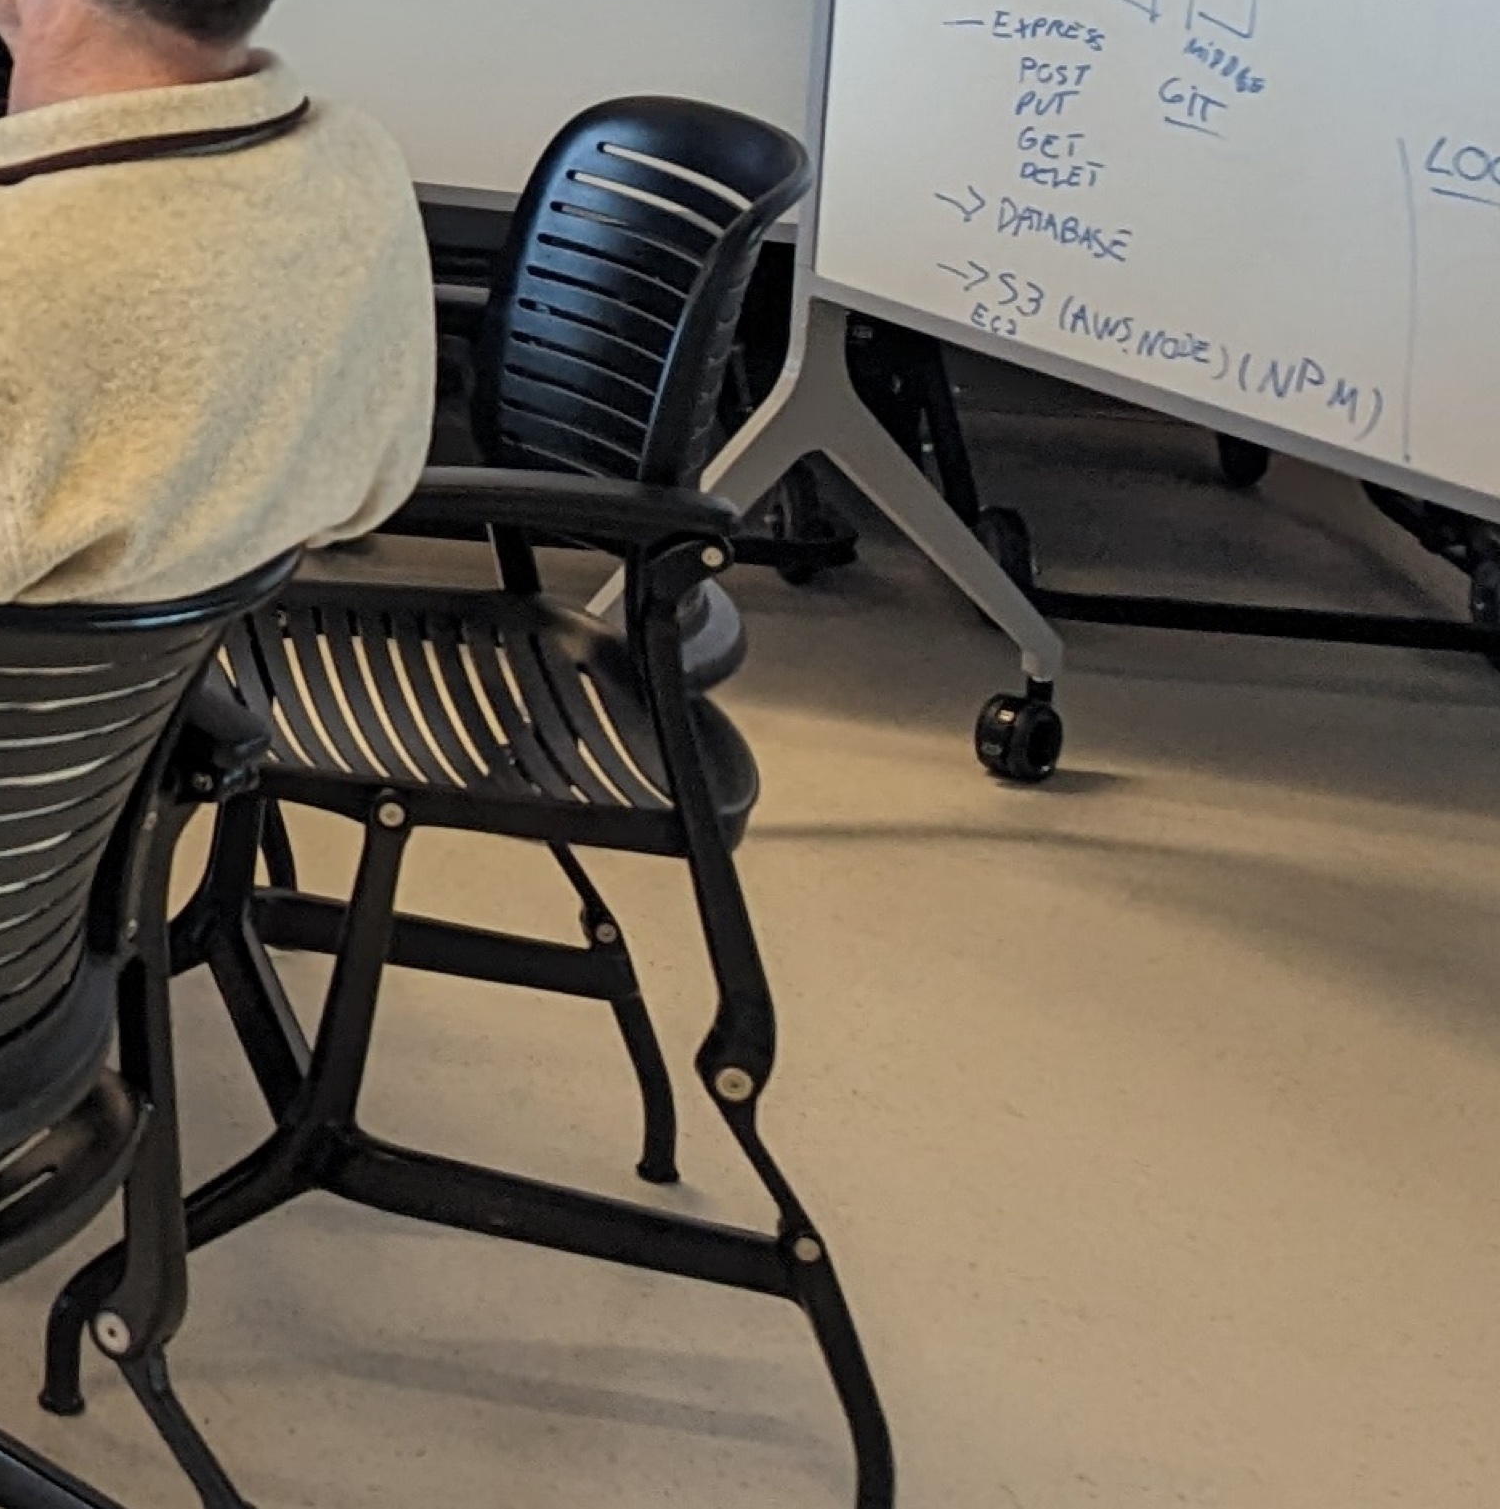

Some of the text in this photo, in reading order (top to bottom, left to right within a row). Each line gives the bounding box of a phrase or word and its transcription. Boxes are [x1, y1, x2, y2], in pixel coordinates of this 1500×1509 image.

[1019, 56, 1092, 88] POST
[1014, 90, 1081, 116] PUT
[1017, 125, 1085, 159] GET
[997, 196, 1133, 263] DATABASE
